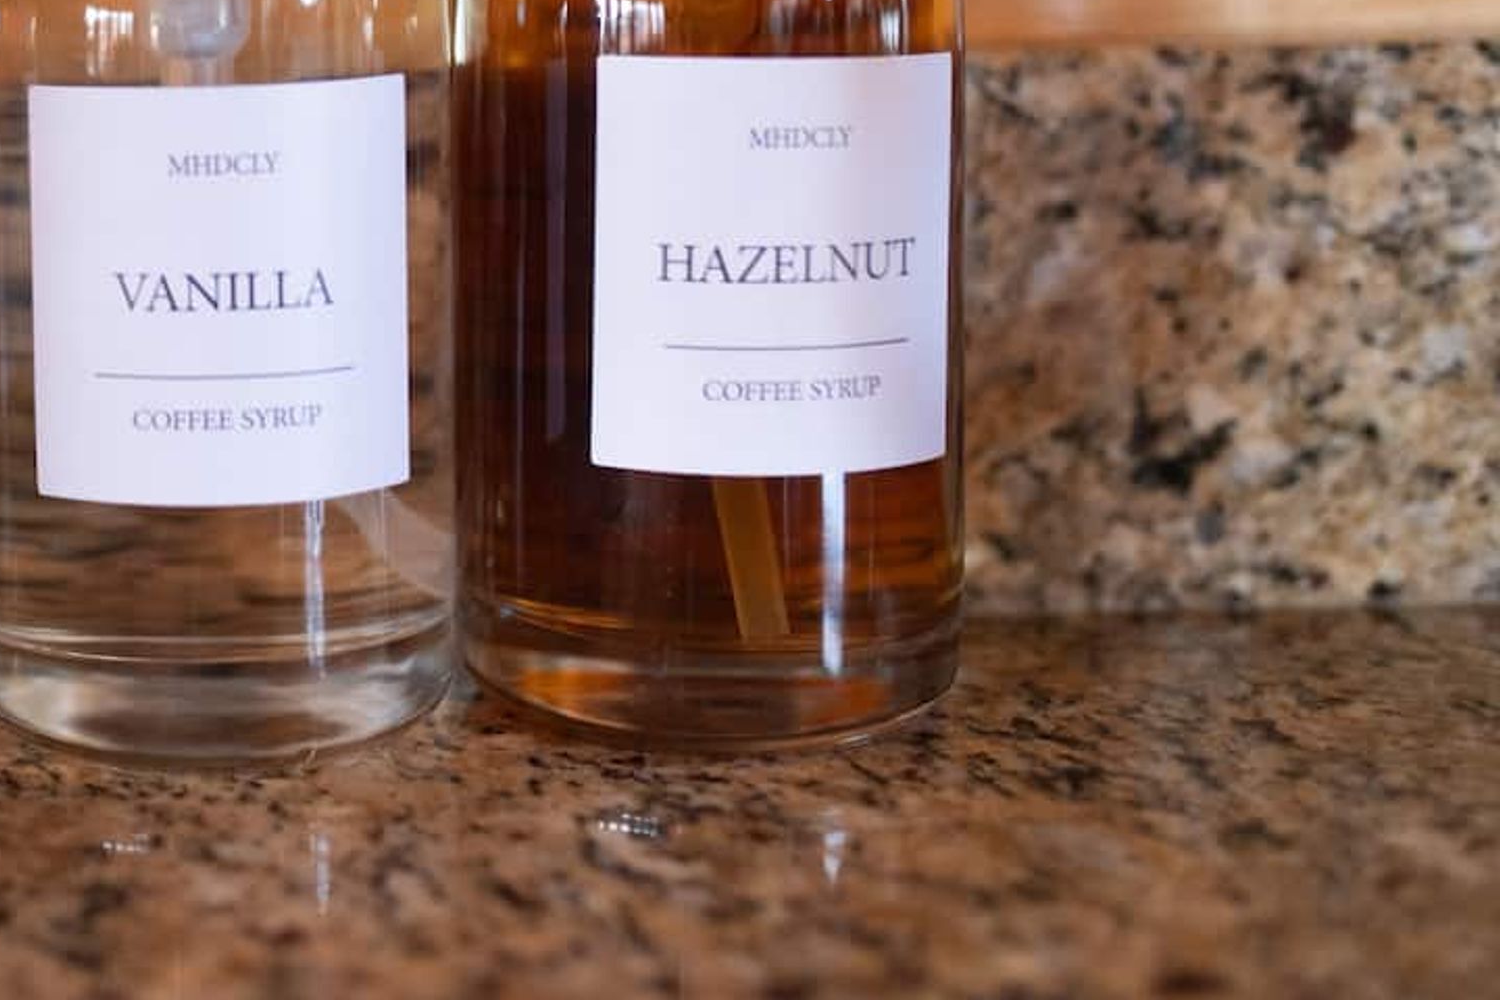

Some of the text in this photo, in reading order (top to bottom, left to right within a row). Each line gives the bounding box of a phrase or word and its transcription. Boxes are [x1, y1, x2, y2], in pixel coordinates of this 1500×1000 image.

[749, 125, 852, 150] MHDCLY
[167, 150, 279, 178] MHDCLY
[658, 236, 916, 285] HAZELNUT
[116, 269, 334, 313] VANILLA
[701, 374, 882, 402] COFFEE SYRUP
[132, 404, 322, 432] COFFEE SYRUP
